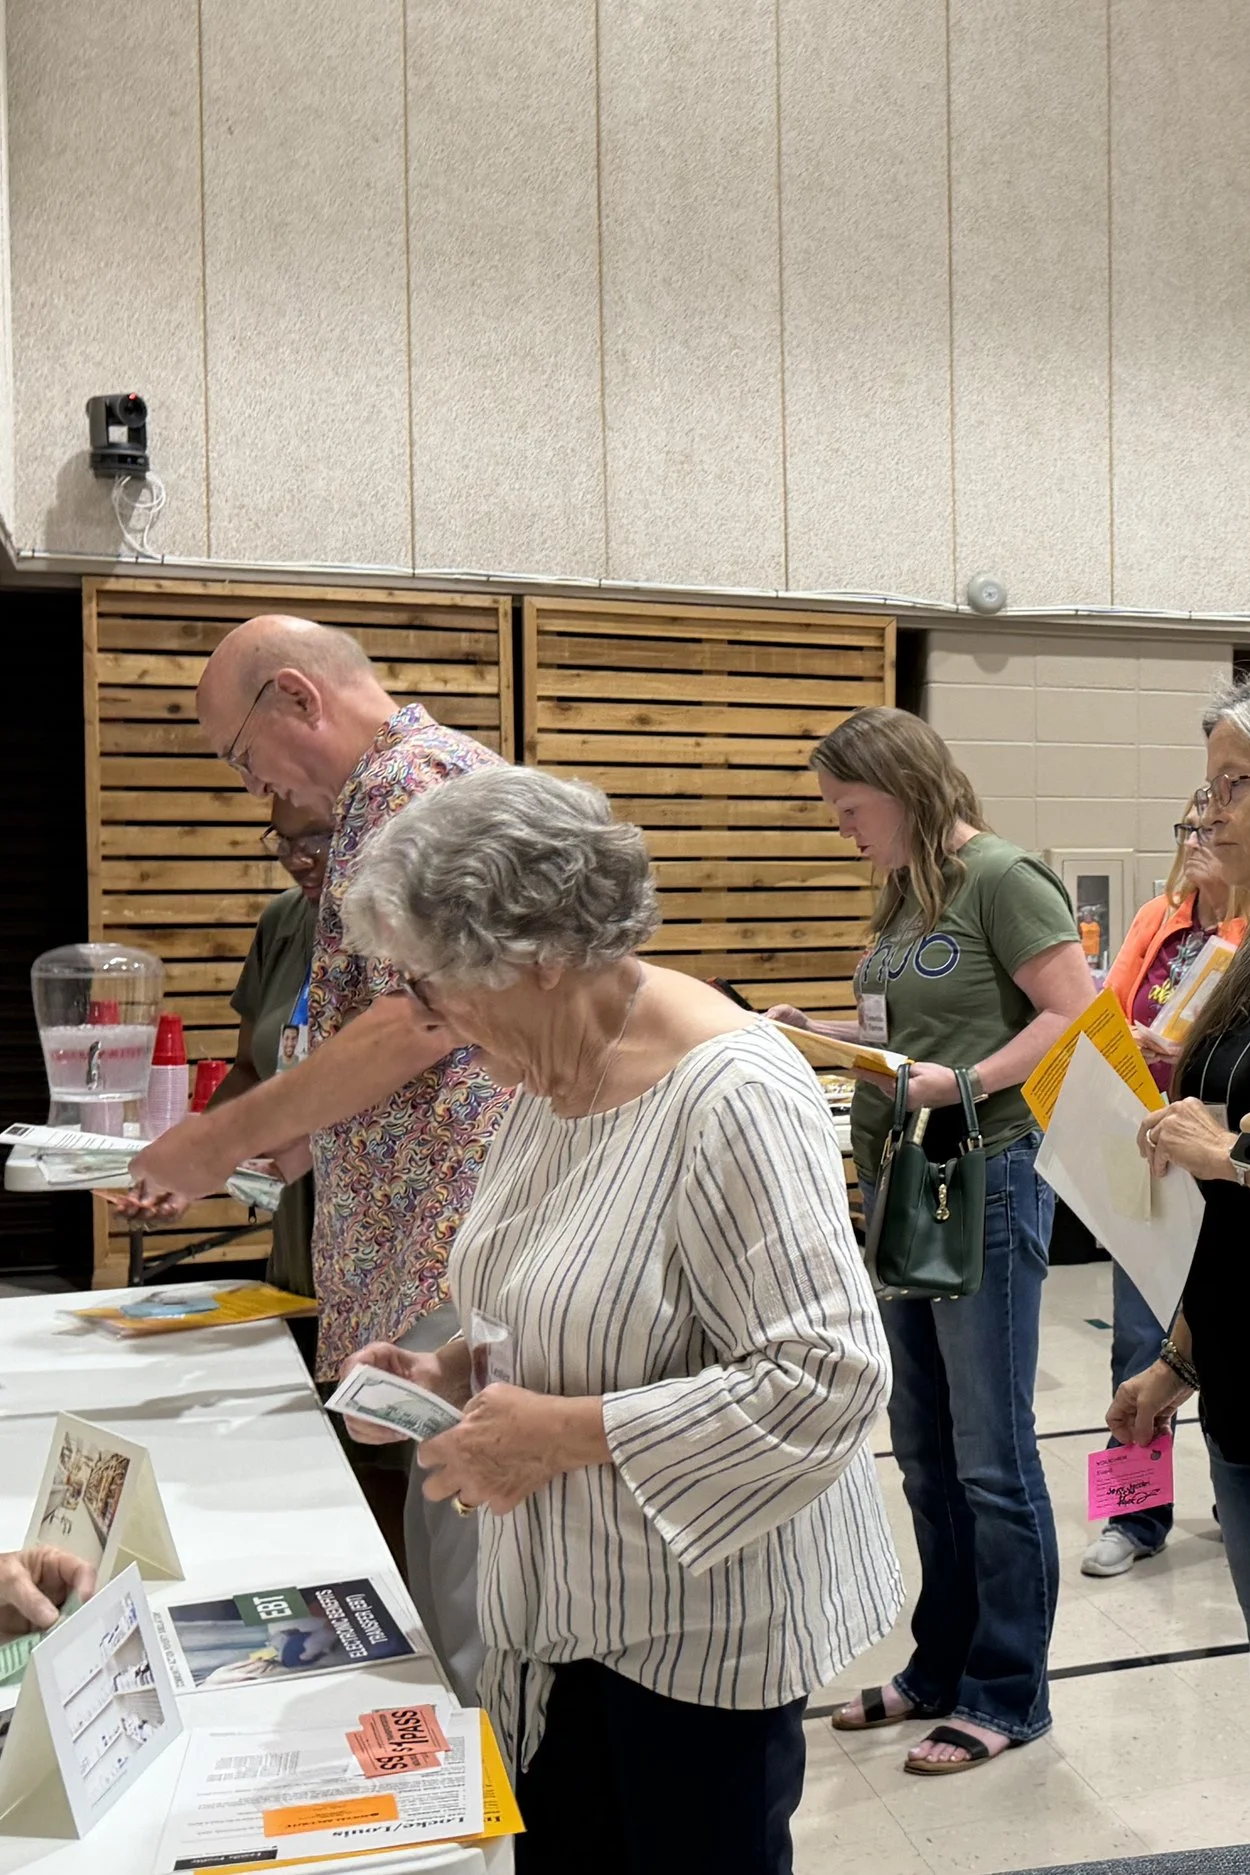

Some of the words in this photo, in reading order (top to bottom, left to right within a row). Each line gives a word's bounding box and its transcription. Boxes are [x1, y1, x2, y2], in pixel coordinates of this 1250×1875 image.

[253, 1595, 293, 1620] EBT
[314, 1588, 346, 1619] BENEFITS
[329, 1616, 368, 1658] ELECTRONIC
[353, 1609, 388, 1644] TRANSFER
[332, 1815, 465, 1839] Locke/Louis
